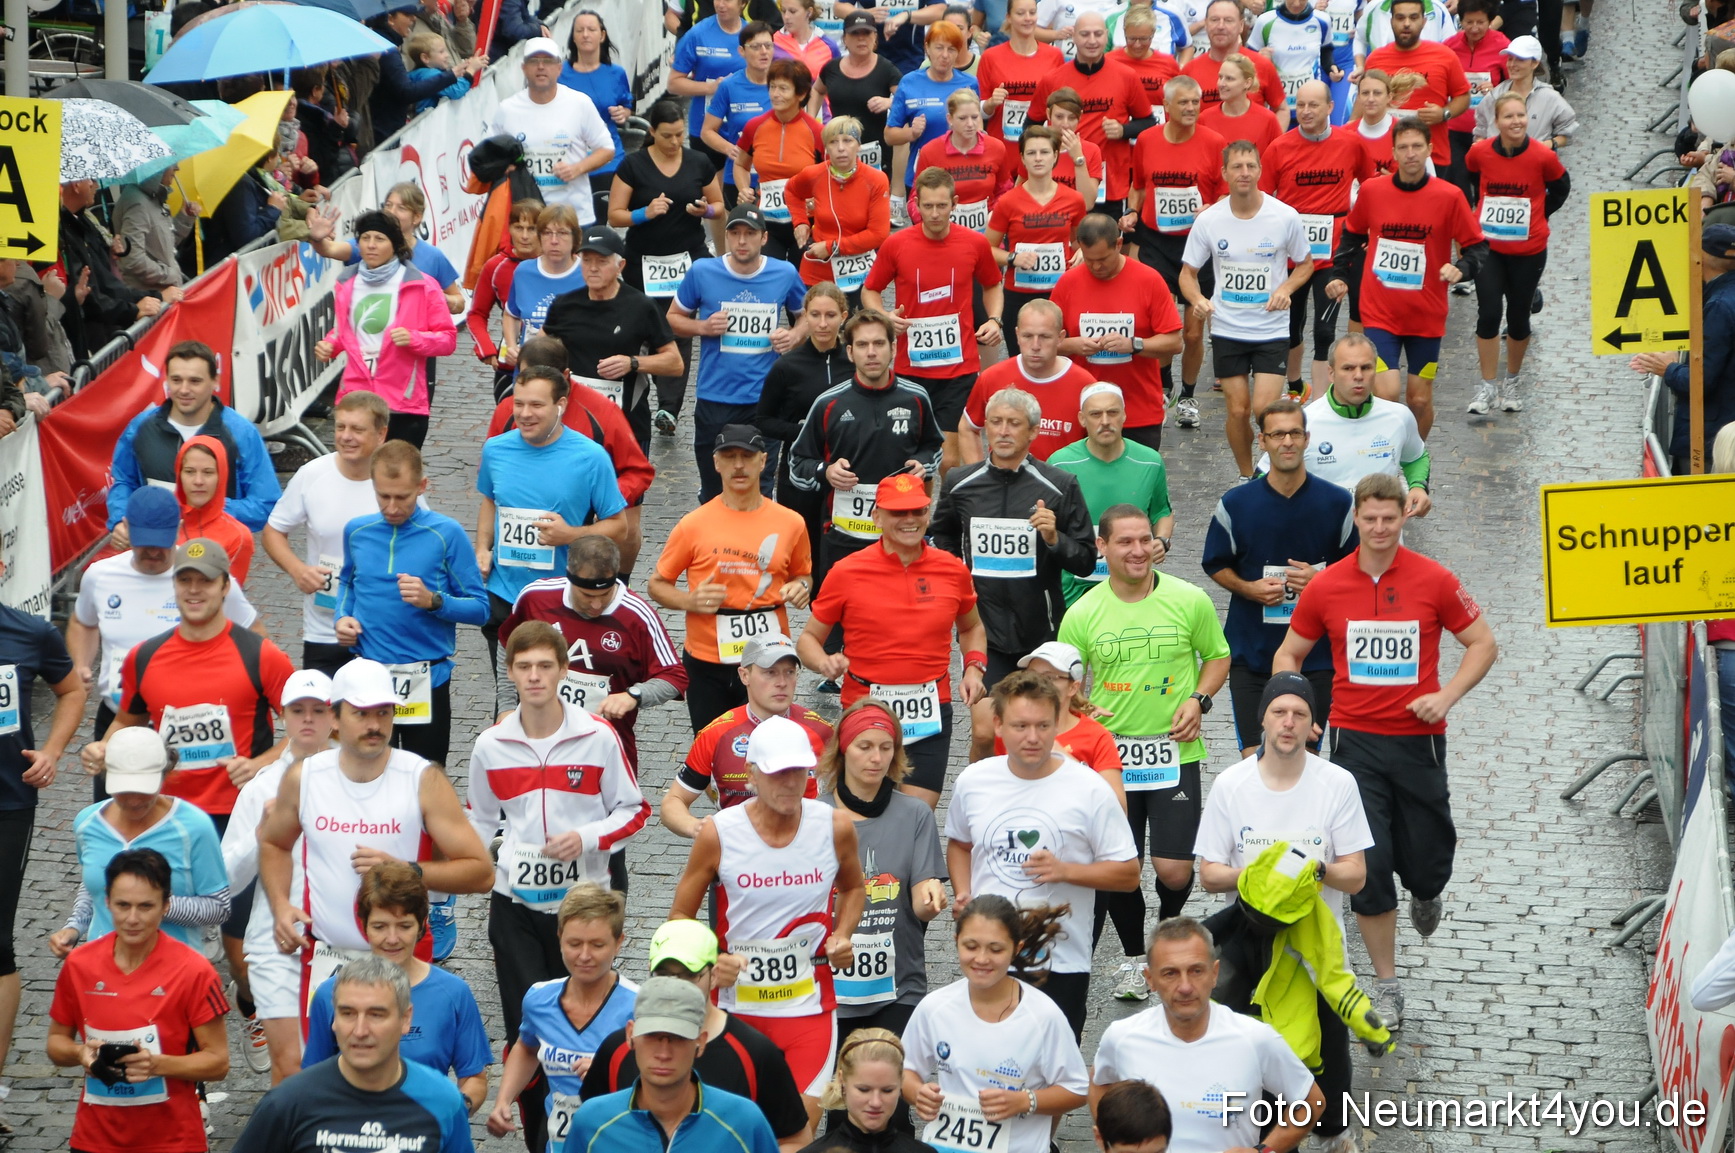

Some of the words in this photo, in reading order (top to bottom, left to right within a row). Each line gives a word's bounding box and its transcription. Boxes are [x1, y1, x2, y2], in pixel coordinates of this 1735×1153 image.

[155, 29, 165, 55] 1
[765, 191, 786, 208] 26
[1160, 198, 1198, 215] 2656
[1486, 207, 1526, 225] 2092
[1603, 196, 1689, 228] Block
[837, 254, 875, 276] 2255
[1379, 251, 1419, 272] 2091
[1028, 275, 1051, 283] Sandra
[1225, 273, 1266, 291] 2020
[1387, 274, 1407, 282] Armin
[1614, 239, 1679, 319] A
[726, 316, 772, 334] 2084
[735, 338, 761, 347] Jochen
[913, 327, 956, 348] 2316
[920, 351, 951, 360] Christian
[892, 420, 909, 435] 44
[848, 521, 876, 532] Florian
[978, 533, 1030, 555] 3058
[1557, 522, 1735, 551] Schnupper
[511, 549, 536, 560] Marcus
[1624, 557, 1684, 586] lauf
[730, 614, 769, 638] 503
[602, 637, 619, 649] FCN
[1355, 637, 1413, 660] 2098
[1367, 666, 1399, 675] Roland
[565, 676, 597, 687] Neumarkt
[1103, 681, 1132, 692] MERZ
[165, 719, 224, 745] 2538
[184, 750, 210, 760] Holm
[1117, 742, 1172, 766] 2935
[1125, 772, 1165, 782] Christian
[315, 815, 401, 835] Oberbank
[1006, 830, 1017, 849] I
[1245, 838, 1271, 846] PARTL
[517, 860, 580, 886] 2864
[737, 867, 824, 889] Oberbank
[537, 892, 559, 902] Luis
[872, 917, 896, 926] 2009
[734, 945, 759, 953] PARTL
[761, 942, 798, 954] Neumarkt
[750, 954, 798, 982] 389
[759, 988, 793, 1000] Martin
[107, 1084, 135, 1095] Petra
[361, 1121, 386, 1136] 40.
[934, 1113, 1002, 1149] 2457
[316, 1129, 427, 1151] Hermannslauf
